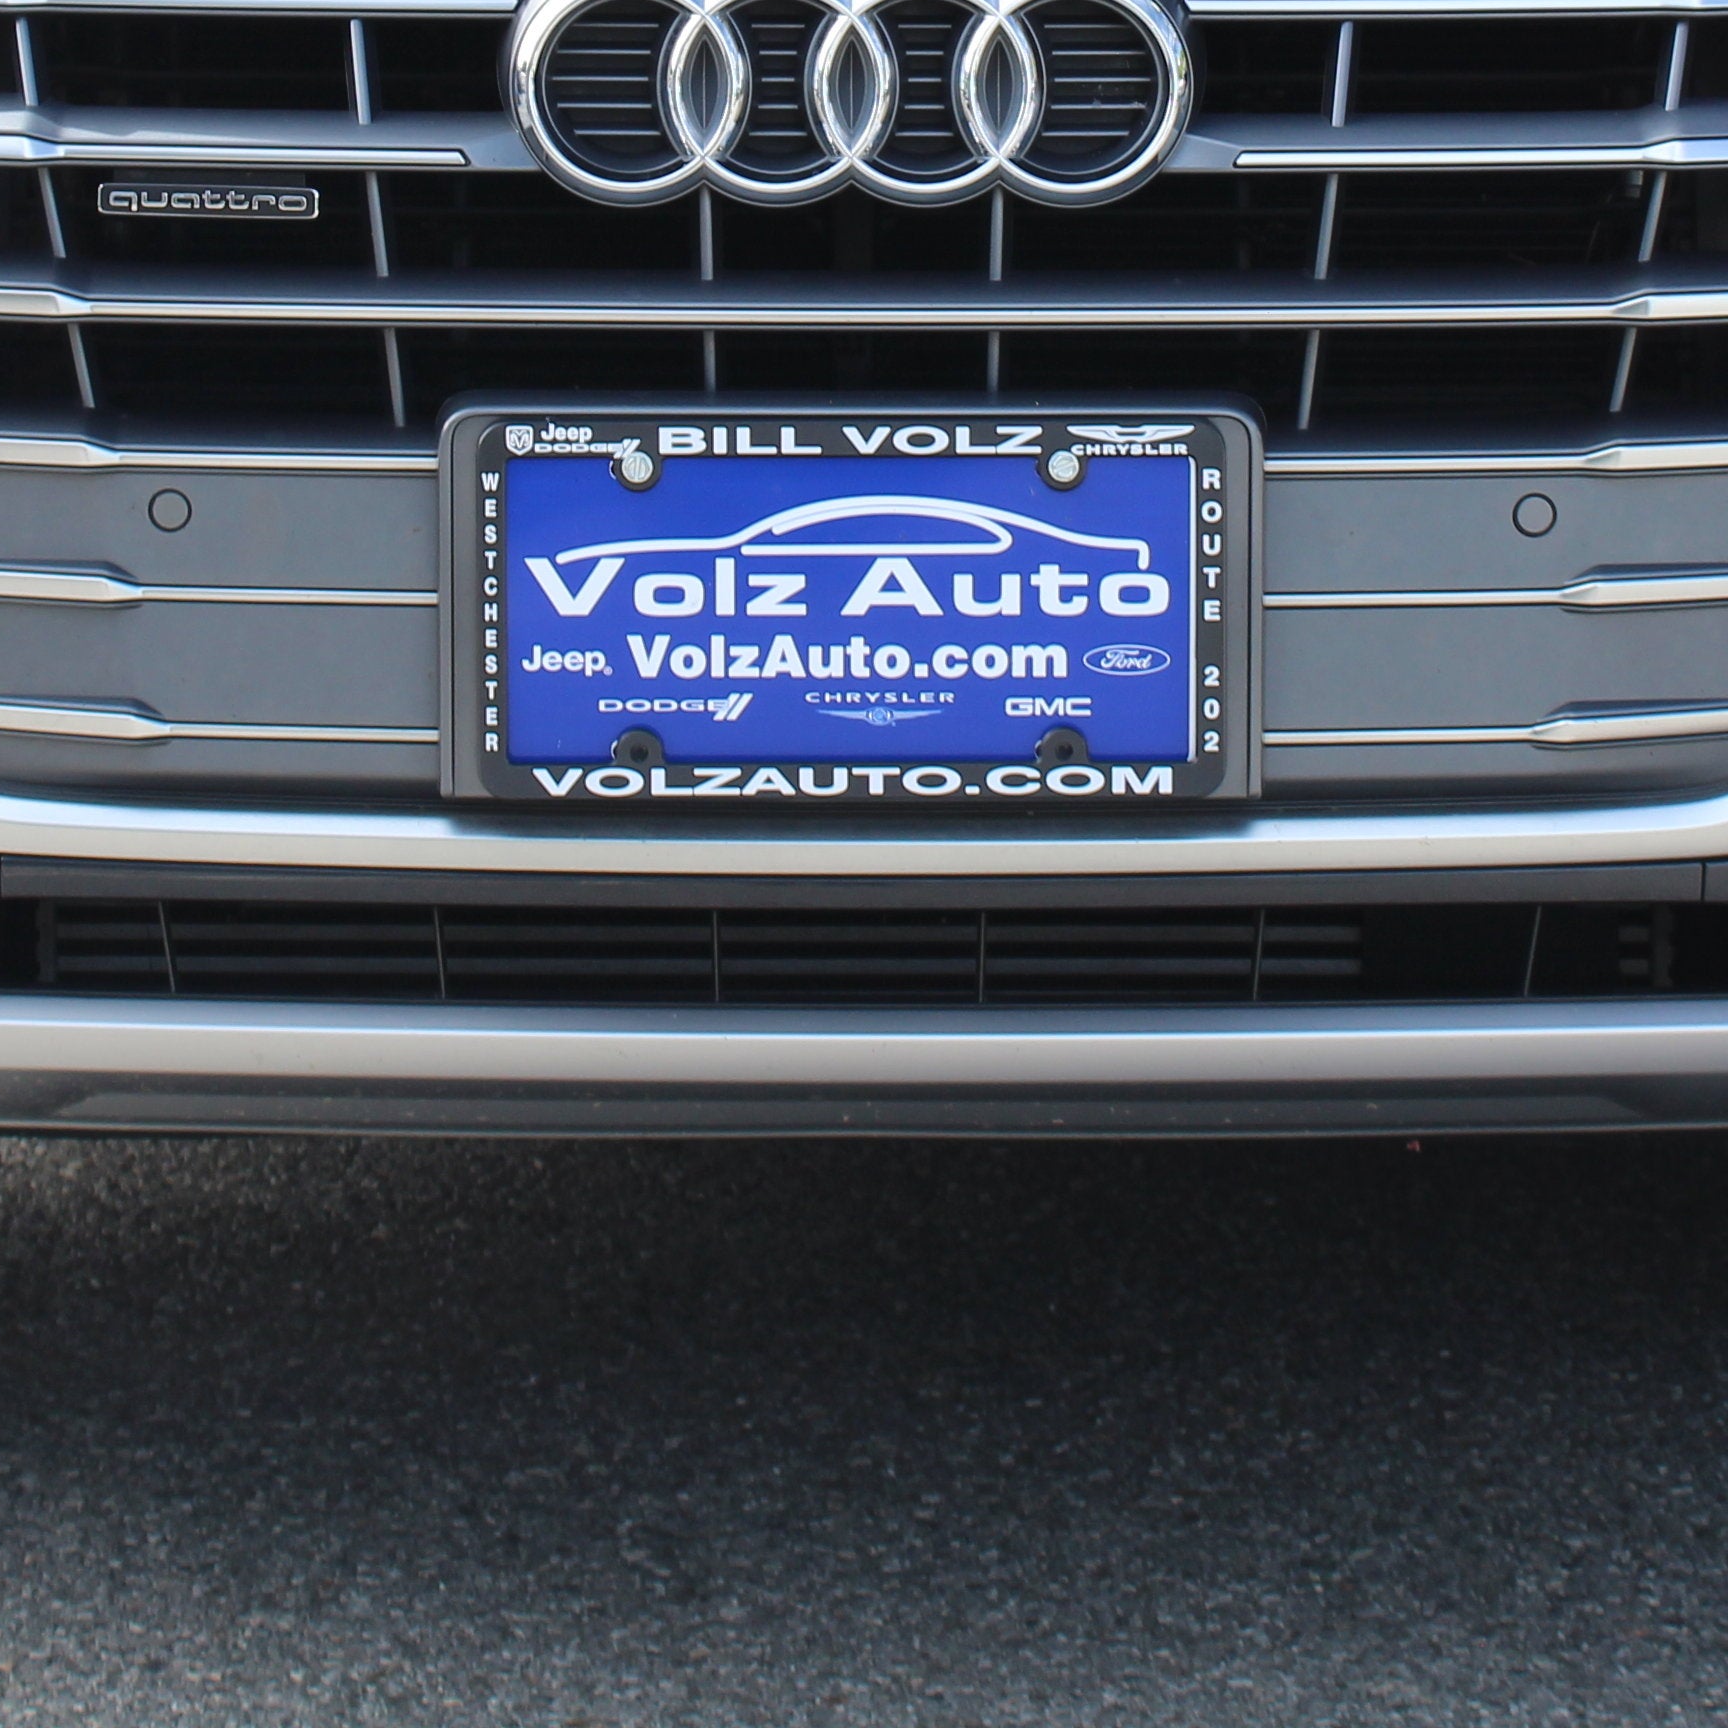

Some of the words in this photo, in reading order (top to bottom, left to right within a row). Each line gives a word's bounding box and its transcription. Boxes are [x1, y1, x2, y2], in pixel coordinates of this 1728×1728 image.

[108, 189, 308, 212] quattro
[540, 423, 593, 443] Jeep
[658, 426, 823, 455] BILL
[847, 426, 1043, 455] VOLZ
[534, 442, 624, 454] DODGE
[1071, 443, 1188, 456] CHRYSLER
[1201, 468, 1223, 621] ROUTE
[524, 556, 808, 617] Volz
[840, 556, 1170, 617] Auto
[481, 472, 500, 752] WESTCHESTER
[522, 645, 607, 677] Jeep
[626, 634, 1068, 679] VolzAuto.com
[1100, 649, 1152, 669] Ford
[598, 699, 729, 713] DODGE
[805, 692, 955, 704] CHRYSLER
[1005, 697, 1092, 717] GMC
[1203, 666, 1220, 752] 202
[532, 766, 1173, 797] VOLZAUTO.COM
